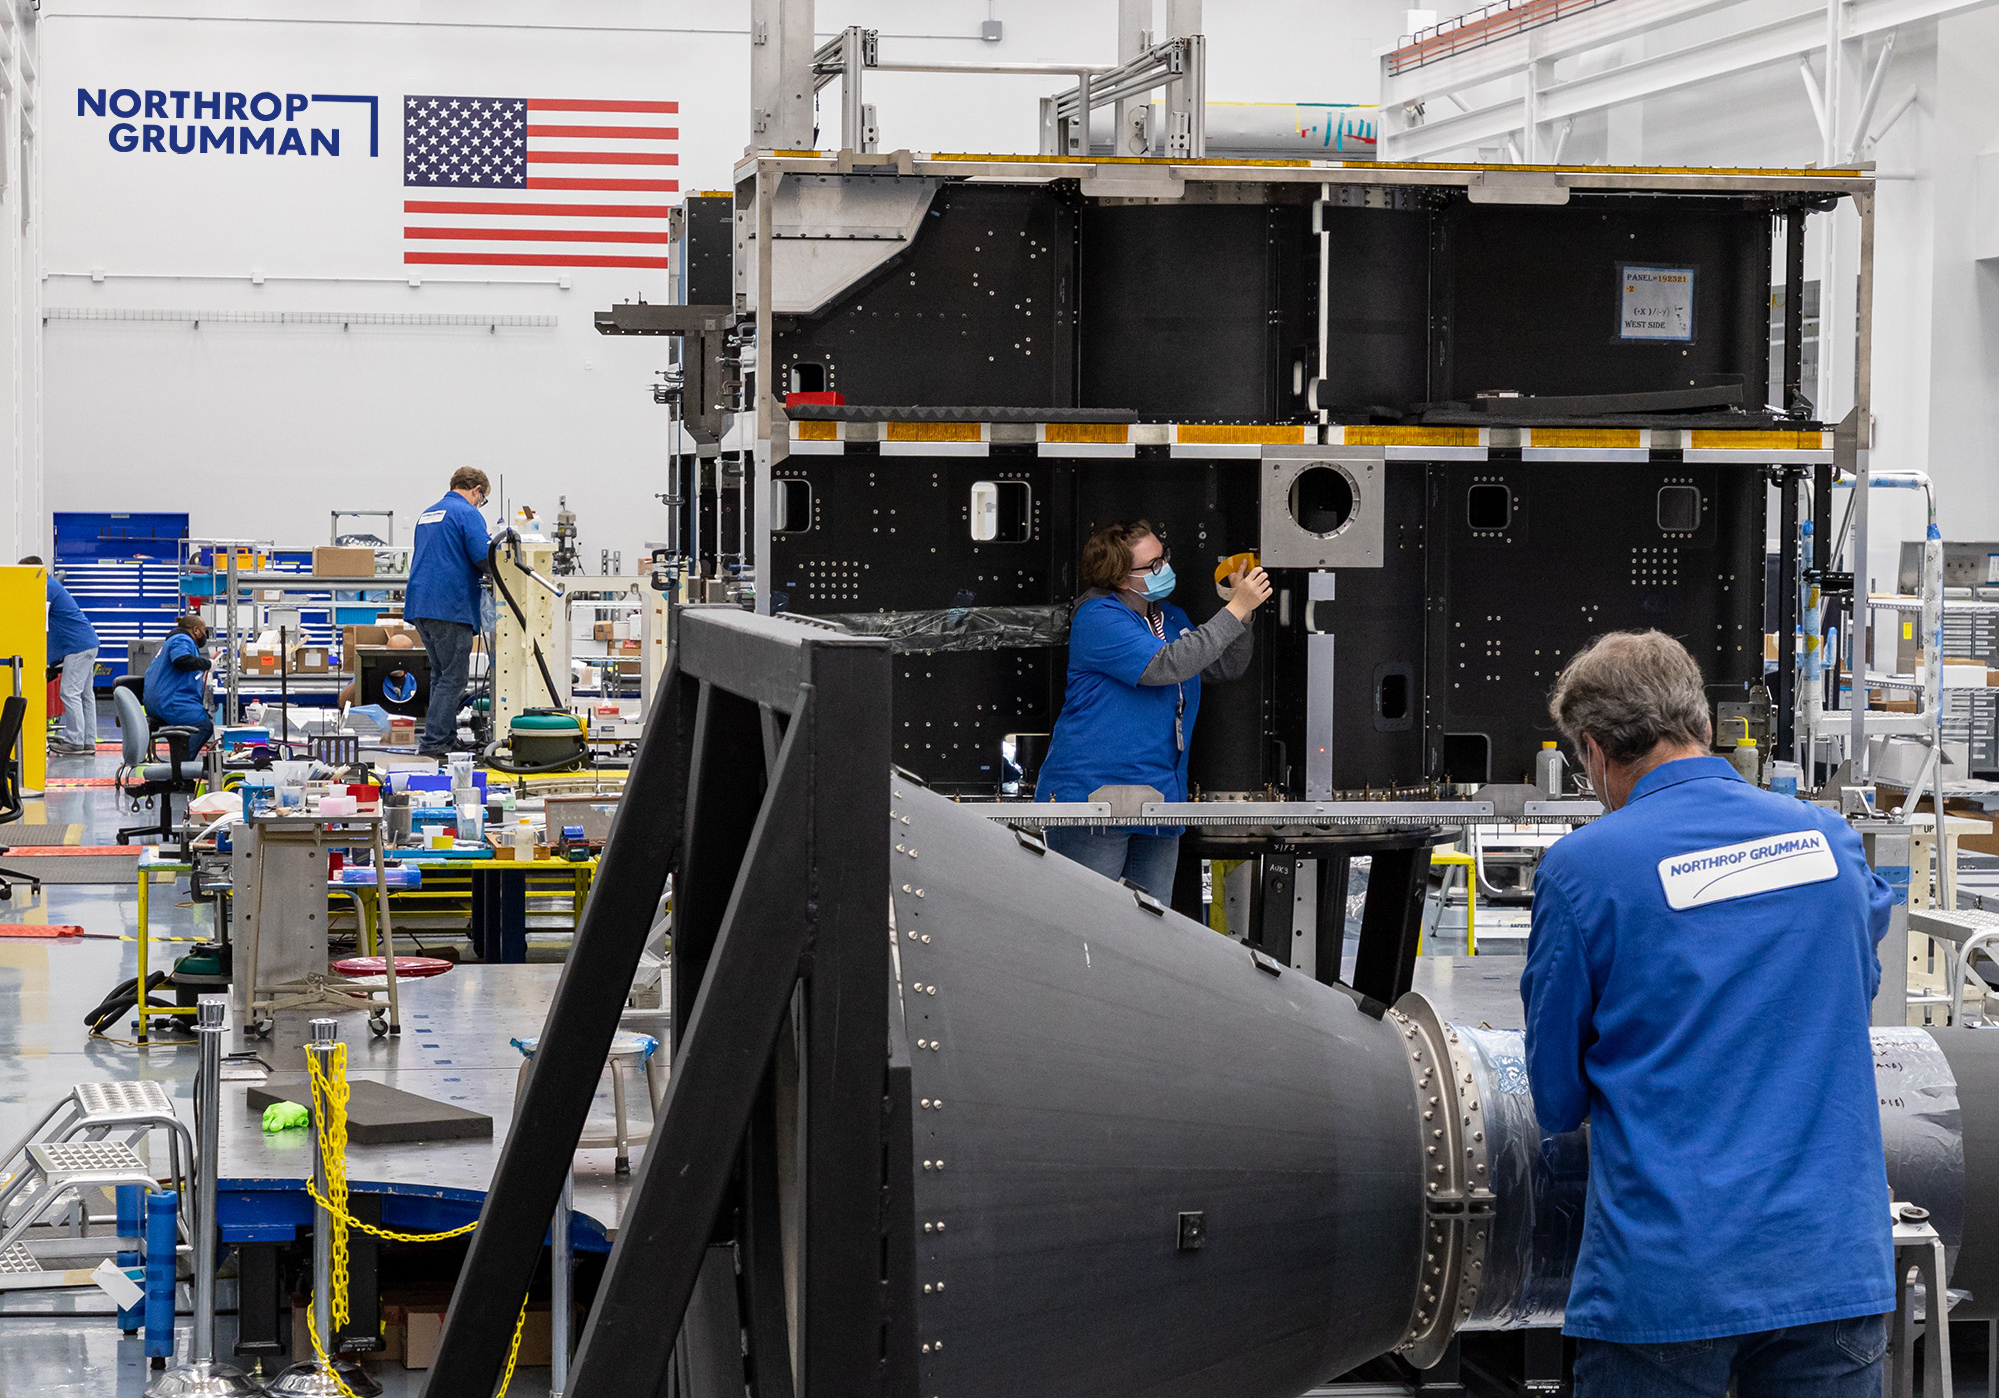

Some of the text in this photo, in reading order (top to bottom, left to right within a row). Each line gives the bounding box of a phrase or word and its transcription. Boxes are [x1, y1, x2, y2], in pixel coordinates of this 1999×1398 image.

[78, 88, 309, 122] NORTHROP
[109, 123, 340, 157] GRUMMAN
[1625, 320, 1666, 330] WEST SIDE
[1923, 824, 1935, 833] UP
[1670, 837, 1820, 877] NORTHROP GRUMMAN
